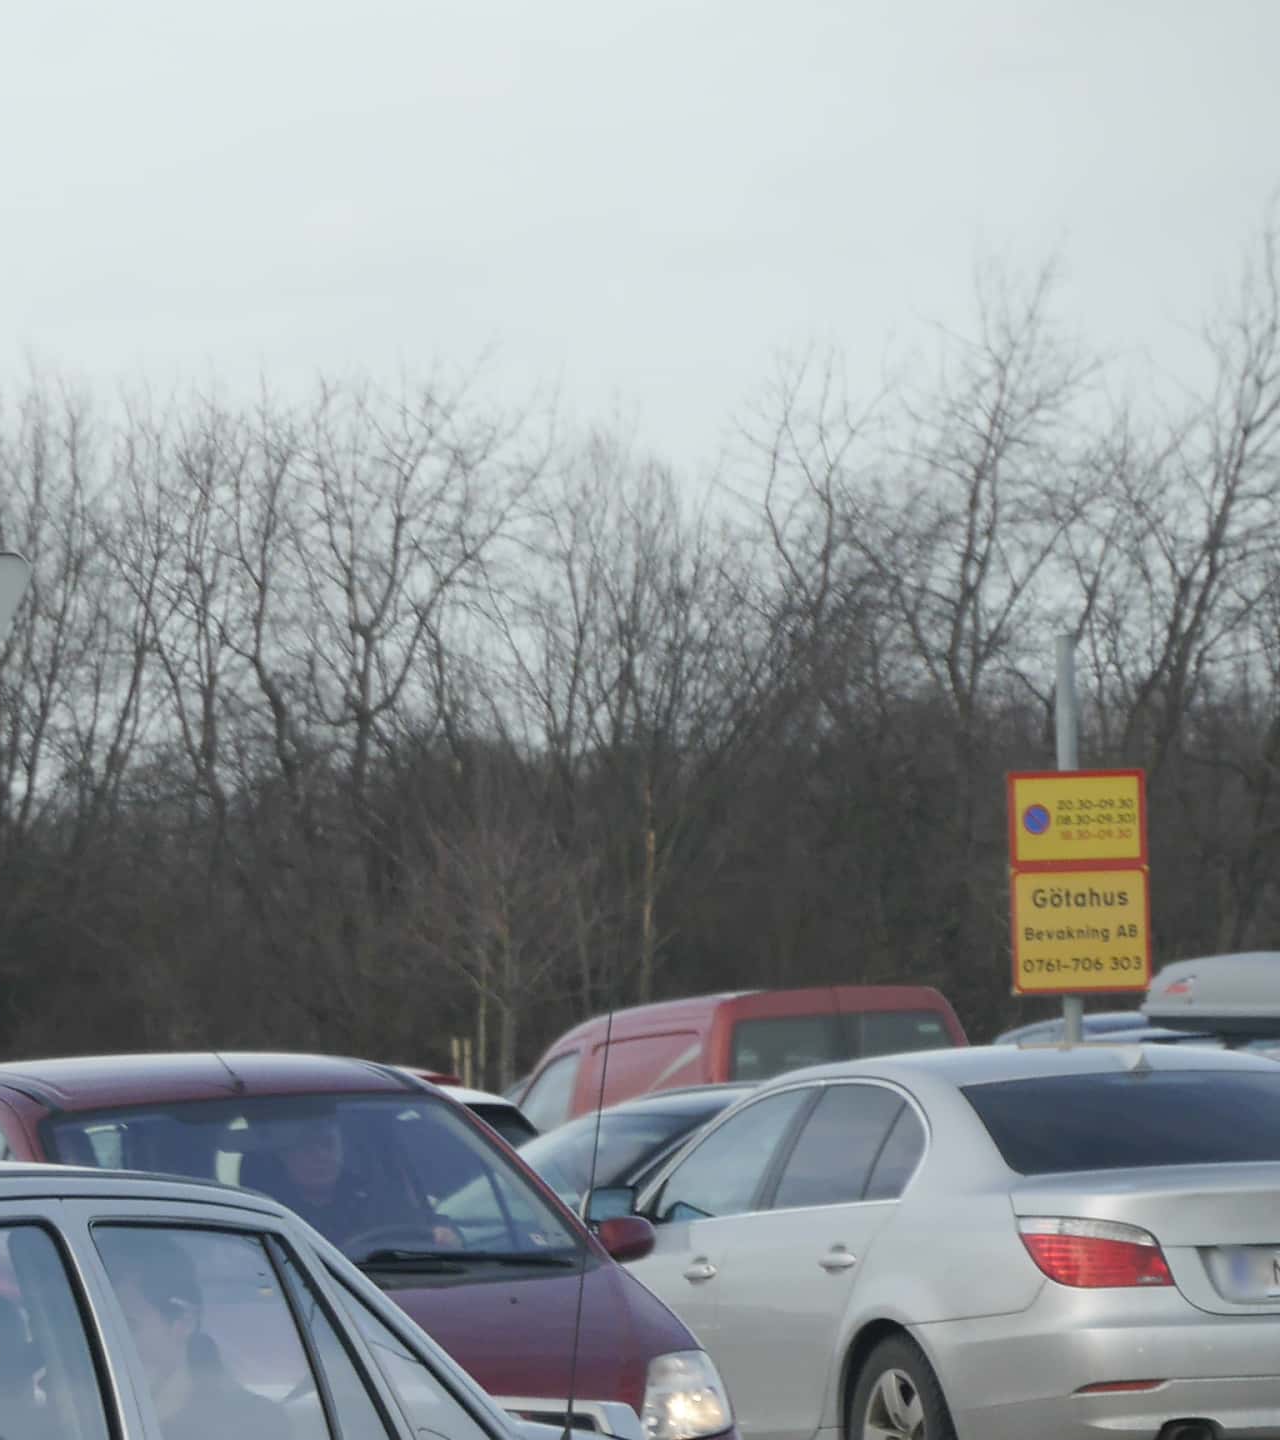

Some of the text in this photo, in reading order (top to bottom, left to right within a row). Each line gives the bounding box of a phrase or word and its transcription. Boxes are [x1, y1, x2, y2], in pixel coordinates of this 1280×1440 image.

[1032, 887, 1129, 909] Götahus
[1024, 924, 1138, 943] Bevakning AB
[1023, 955, 1142, 974] 0761-706 303
